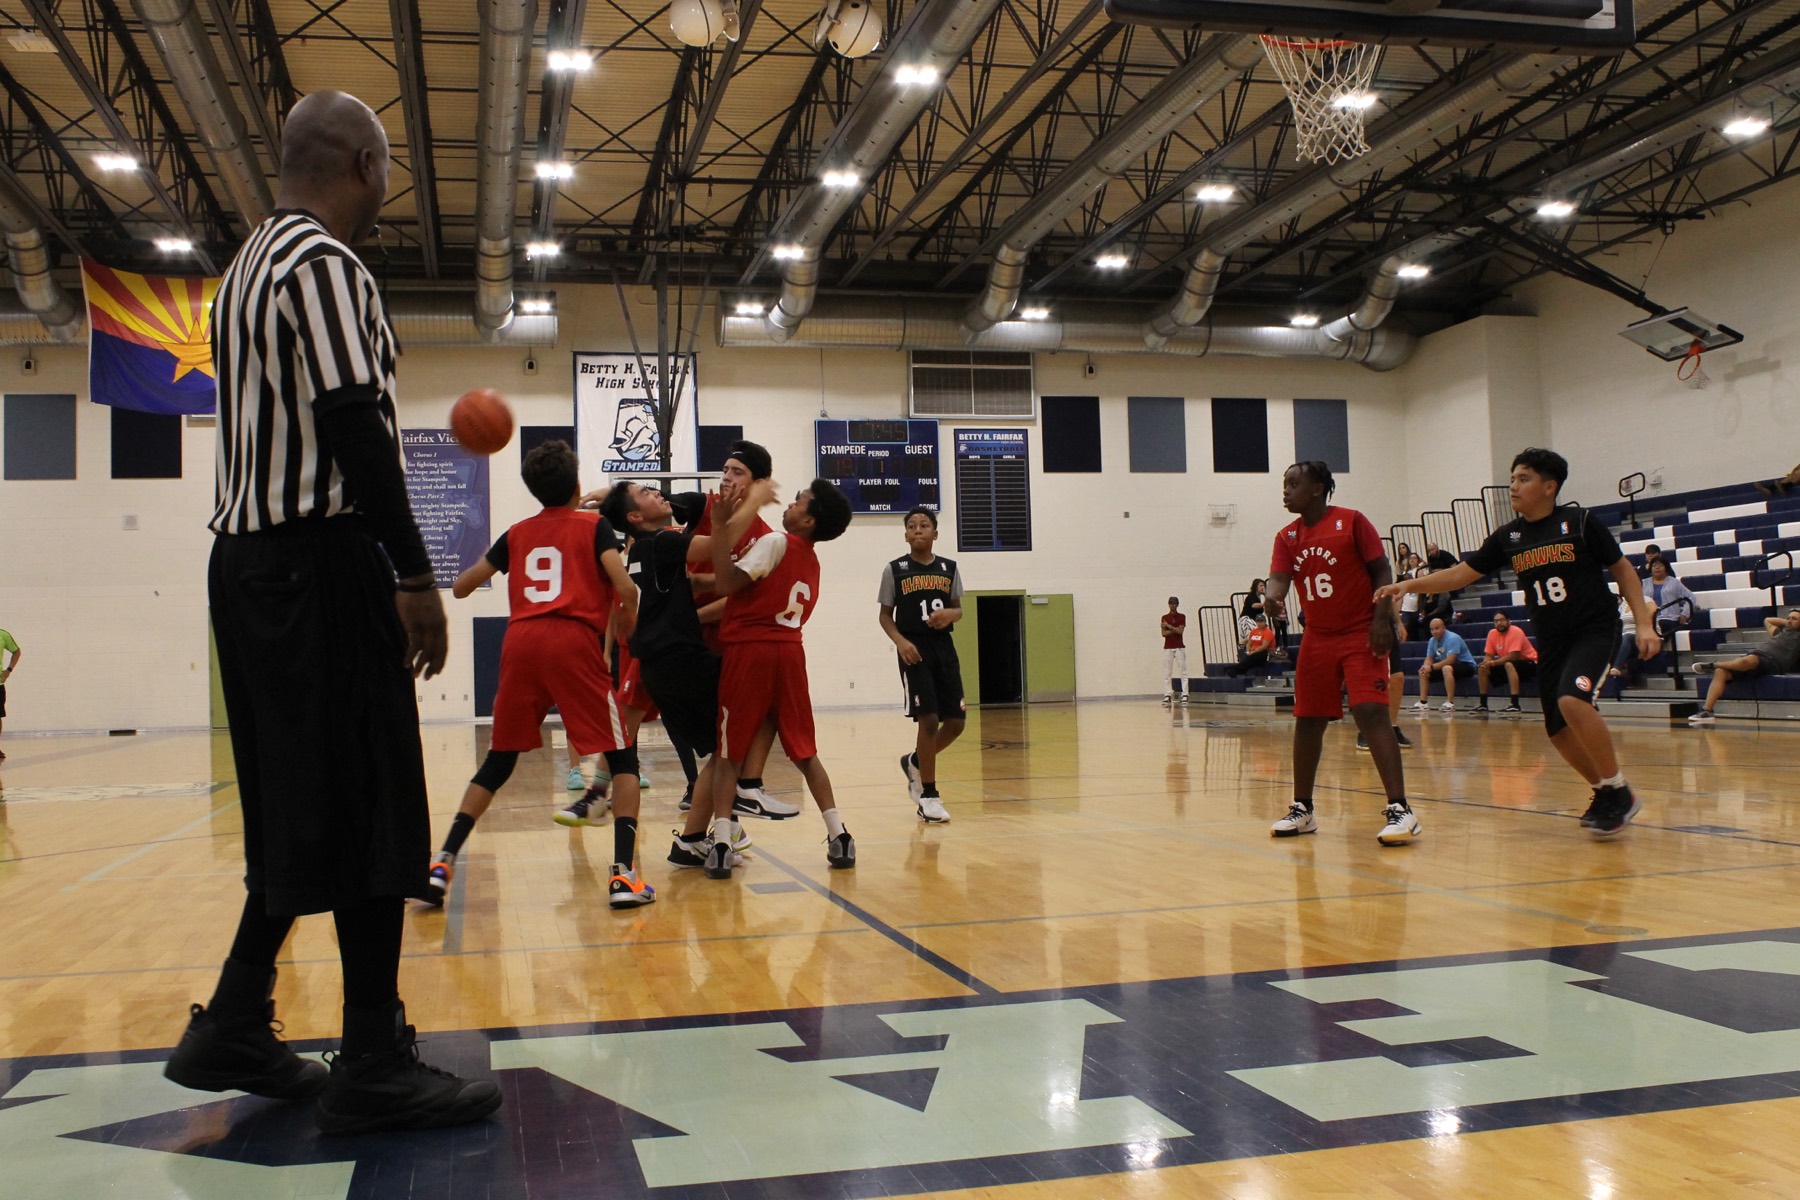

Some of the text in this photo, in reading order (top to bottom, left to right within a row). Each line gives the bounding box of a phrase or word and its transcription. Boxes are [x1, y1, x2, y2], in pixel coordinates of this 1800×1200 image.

[580, 363, 618, 374] BETTY
[624, 363, 636, 374] H.
[595, 377, 626, 389] HIGH
[958, 433, 1024, 441] BETTY H. FAIRFAX
[821, 445, 866, 455] STAMPEDE
[905, 445, 933, 455] GUEST
[1293, 547, 1338, 572] RAPTORS
[1512, 543, 1575, 574] HAWKS
[523, 546, 562, 603] 9
[901, 575, 951, 595] HAWKS
[1303, 573, 1333, 601] 16
[1533, 576, 1567, 606] 18
[775, 580, 811, 629] 6
